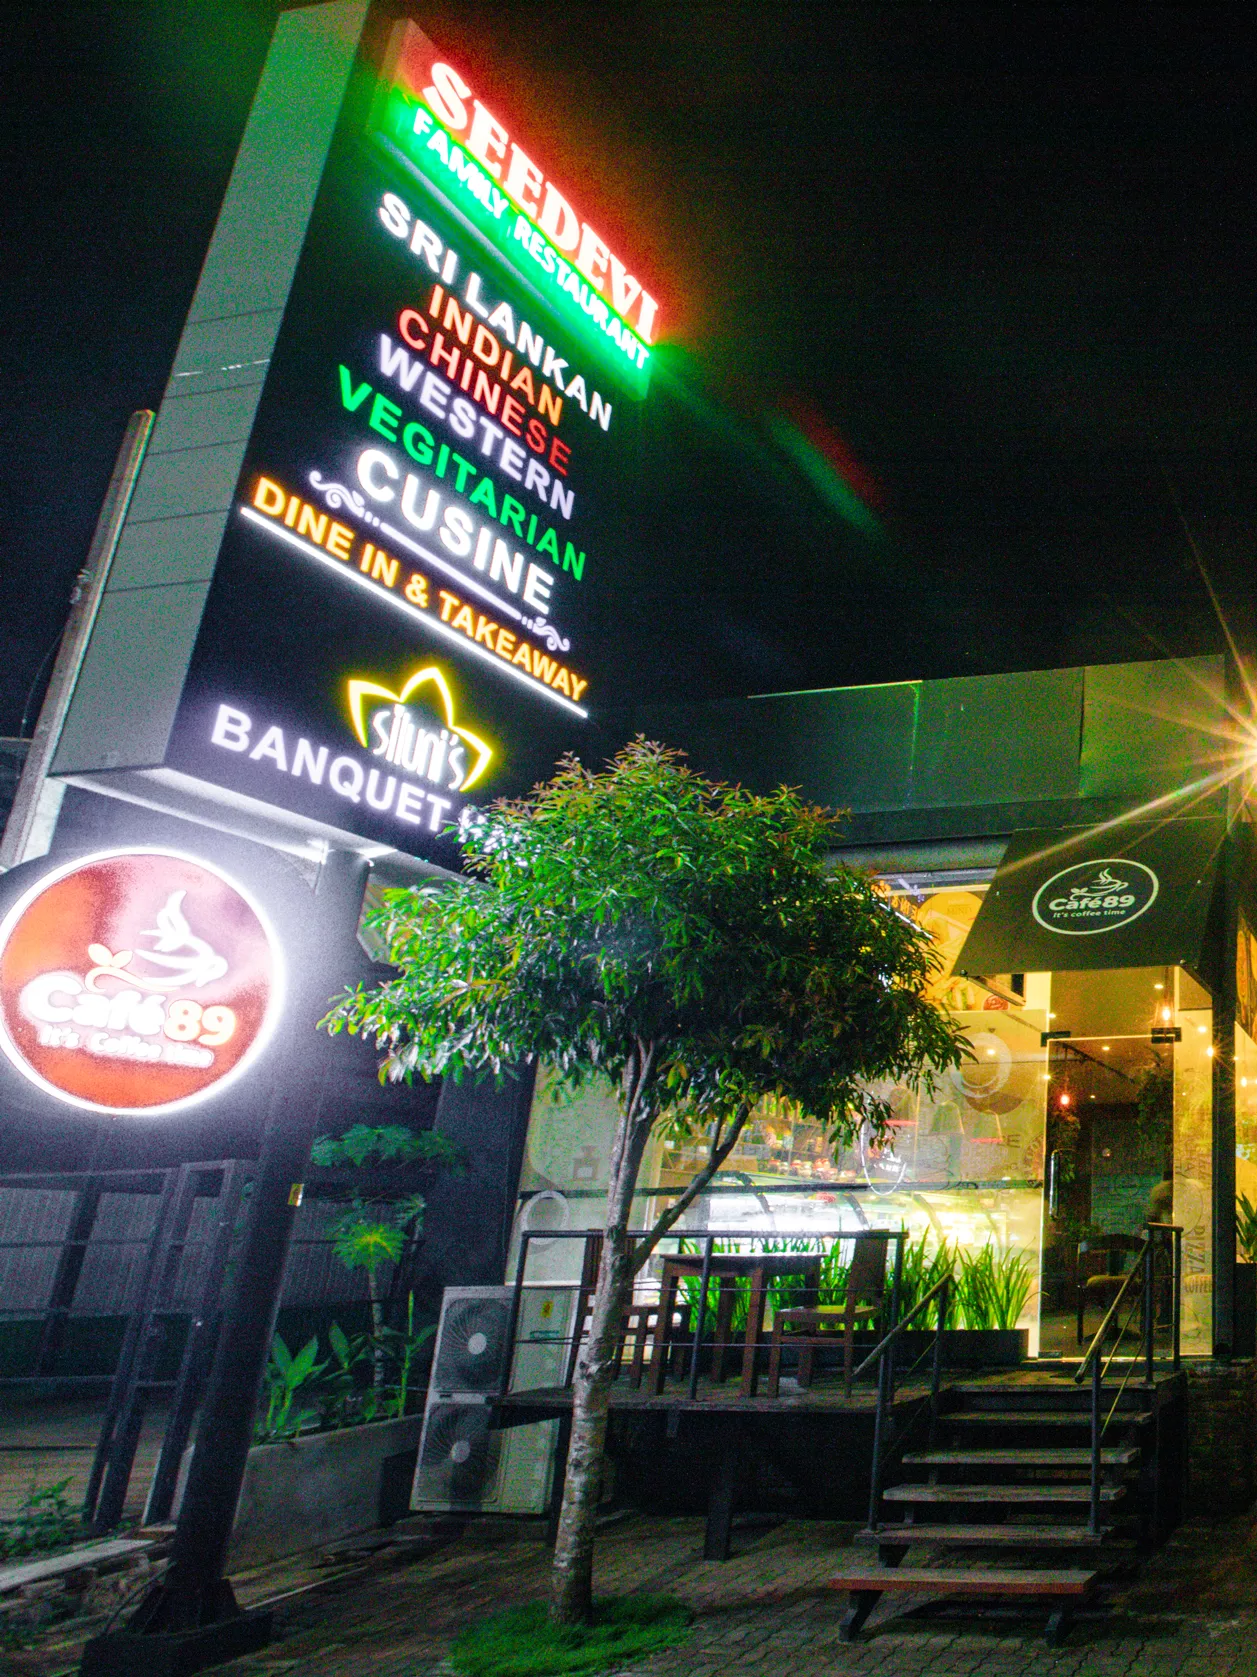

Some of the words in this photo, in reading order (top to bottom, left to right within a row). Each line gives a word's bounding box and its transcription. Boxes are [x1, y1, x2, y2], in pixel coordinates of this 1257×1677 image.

[413, 107, 509, 219] FAMILY
[513, 208, 650, 369] RESTAURANT
[422, 62, 659, 345] SEEDEVI
[378, 192, 459, 284] SRI
[466, 272, 613, 431] LANKAN
[399, 309, 572, 475] CHINESE
[429, 284, 563, 426] INDIAN
[338, 364, 586, 581] VEGITARIAN
[380, 334, 575, 520] WESTERN
[252, 477, 354, 560] DINE
[360, 542, 399, 588] IN
[405, 574, 428, 607] &
[440, 590, 587, 701] TAKEAWAY
[357, 449, 554, 614] CUSINE
[211, 703, 451, 832] BANQUET
[1070, 910, 1102, 918] coffee
